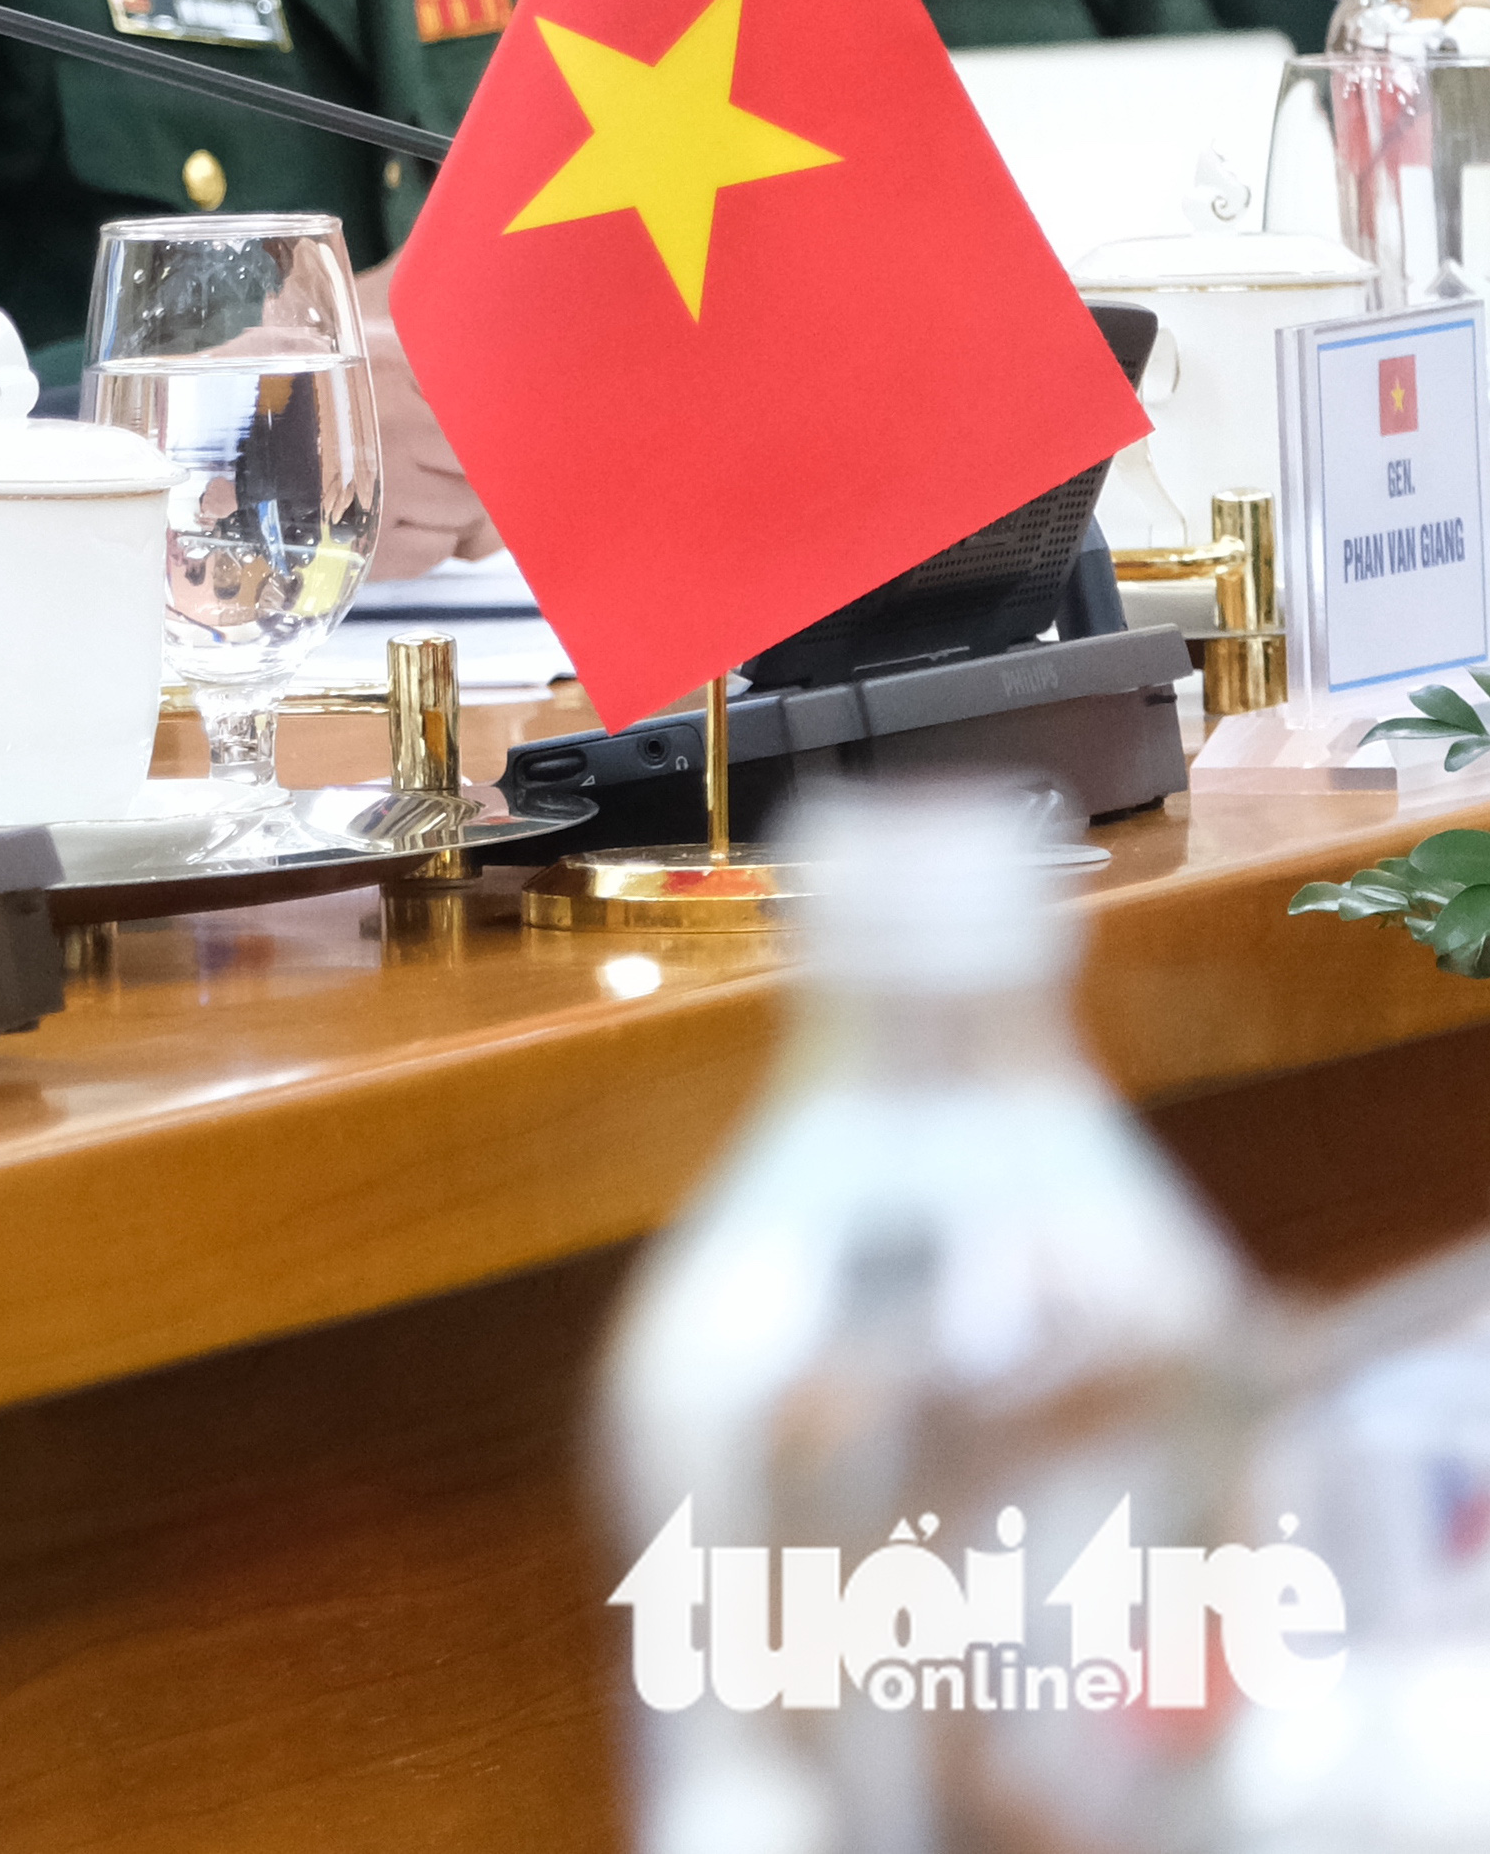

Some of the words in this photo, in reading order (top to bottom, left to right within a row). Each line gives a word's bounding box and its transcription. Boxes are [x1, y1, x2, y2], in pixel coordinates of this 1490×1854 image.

[1387, 459, 1416, 498] GEN.
[1343, 533, 1384, 583] PHAN
[1387, 526, 1417, 575] VAN
[1421, 517, 1465, 569] GIANG
